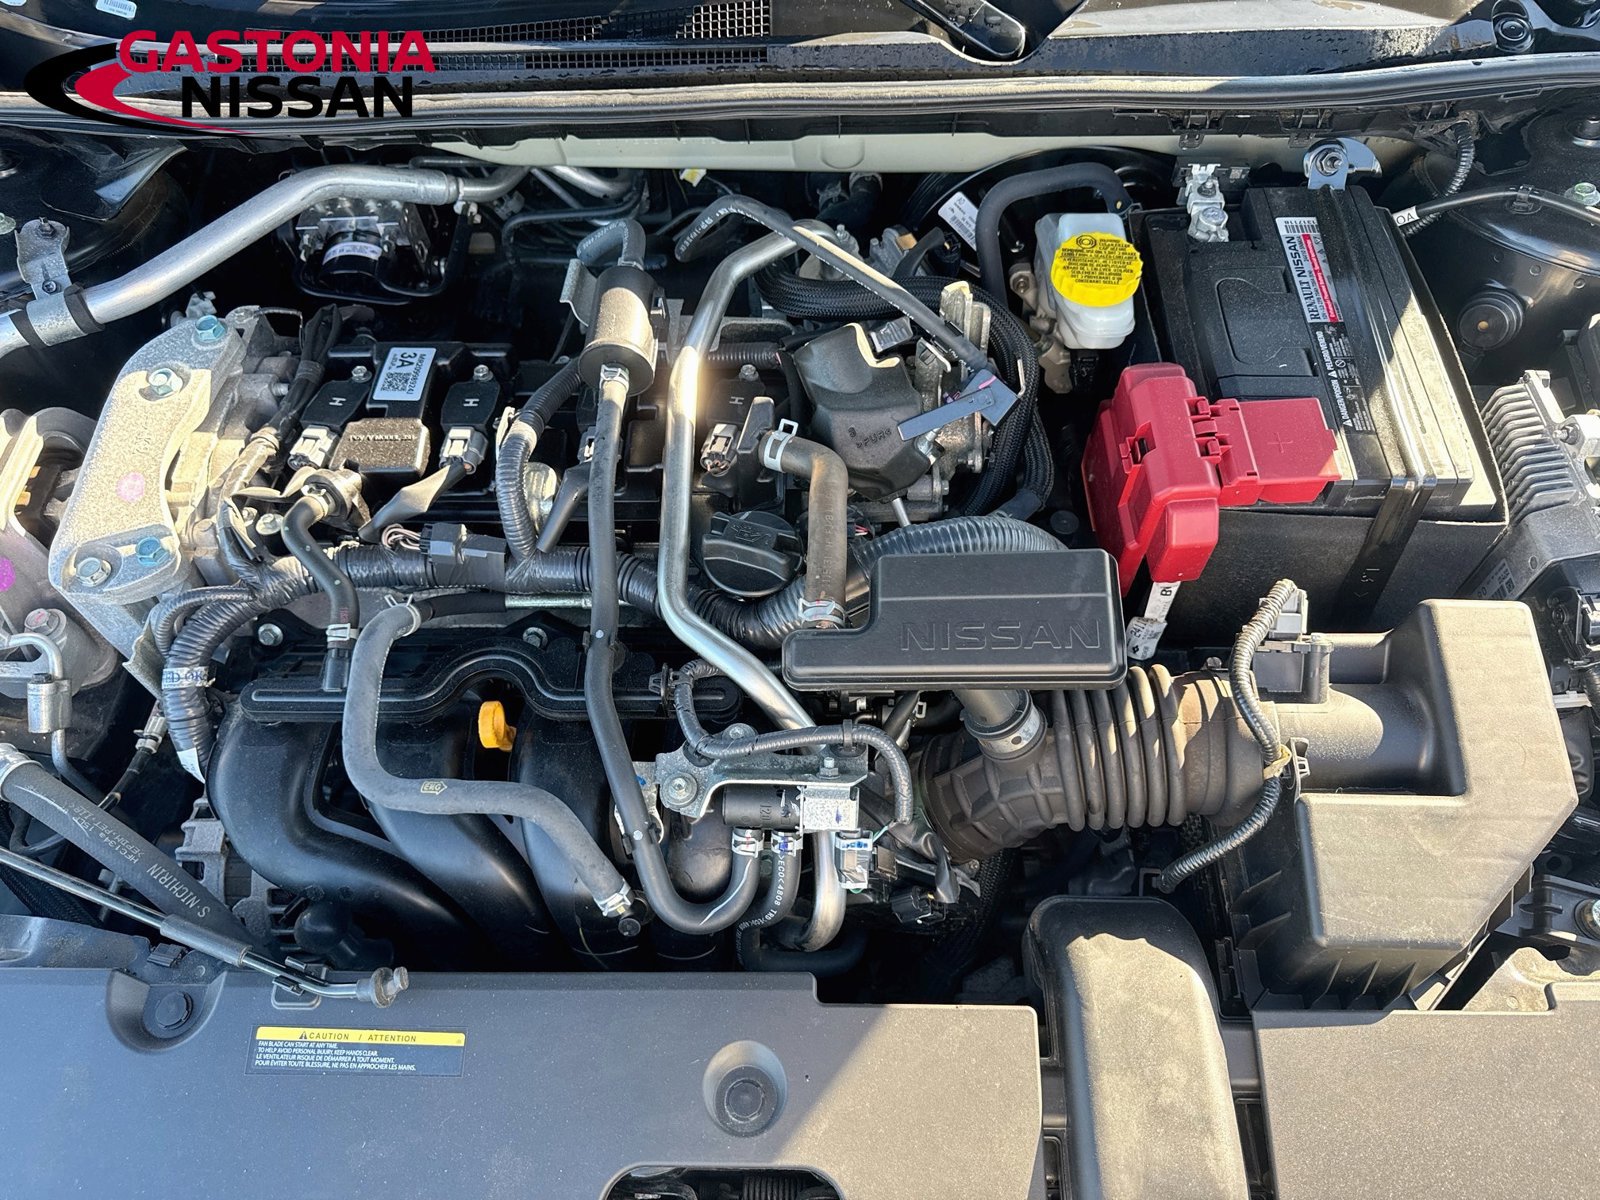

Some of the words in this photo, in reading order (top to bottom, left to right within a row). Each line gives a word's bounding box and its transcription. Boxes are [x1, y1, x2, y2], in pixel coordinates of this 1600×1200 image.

[1285, 236, 1307, 278] NISSAN
[1299, 282, 1320, 320] RENAULT
[396, 352, 418, 368] 3A
[1331, 380, 1350, 420] DANGER/POISON
[900, 620, 1100, 651] NISSAN
[309, 1032, 349, 1040] CAUTION
[368, 1034, 416, 1042] ATTENTION
